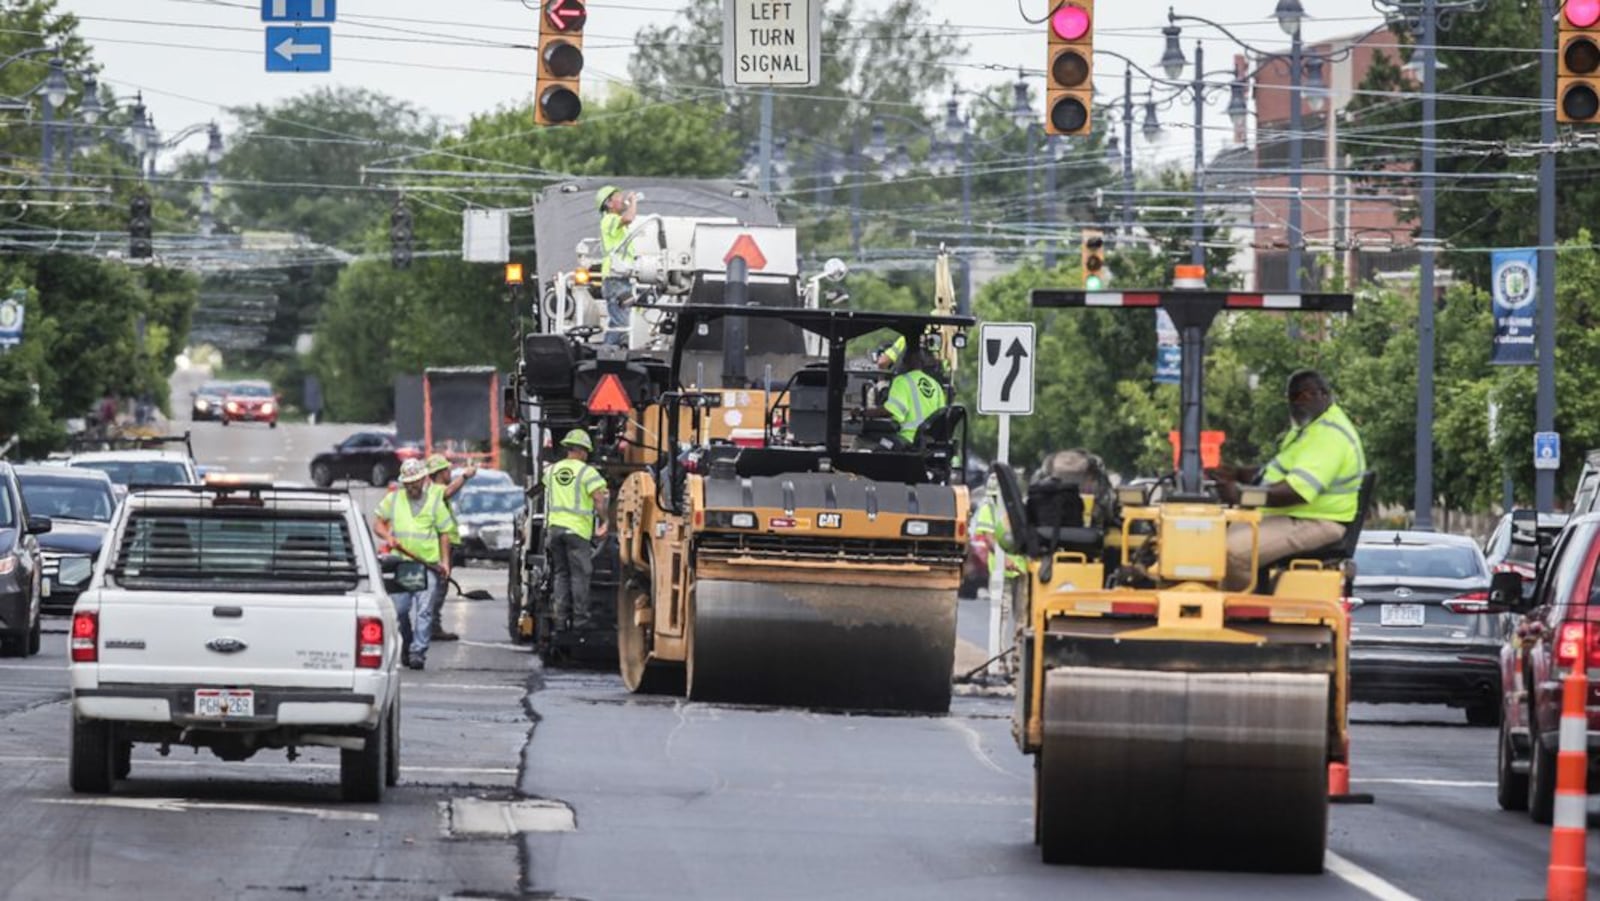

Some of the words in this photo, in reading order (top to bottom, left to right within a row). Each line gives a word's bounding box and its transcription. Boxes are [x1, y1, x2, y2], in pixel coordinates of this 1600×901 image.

[751, 3, 791, 20] LEFT
[750, 28, 794, 46] TURN
[740, 54, 803, 72] SIGNAL
[819, 514, 839, 527] CAT
